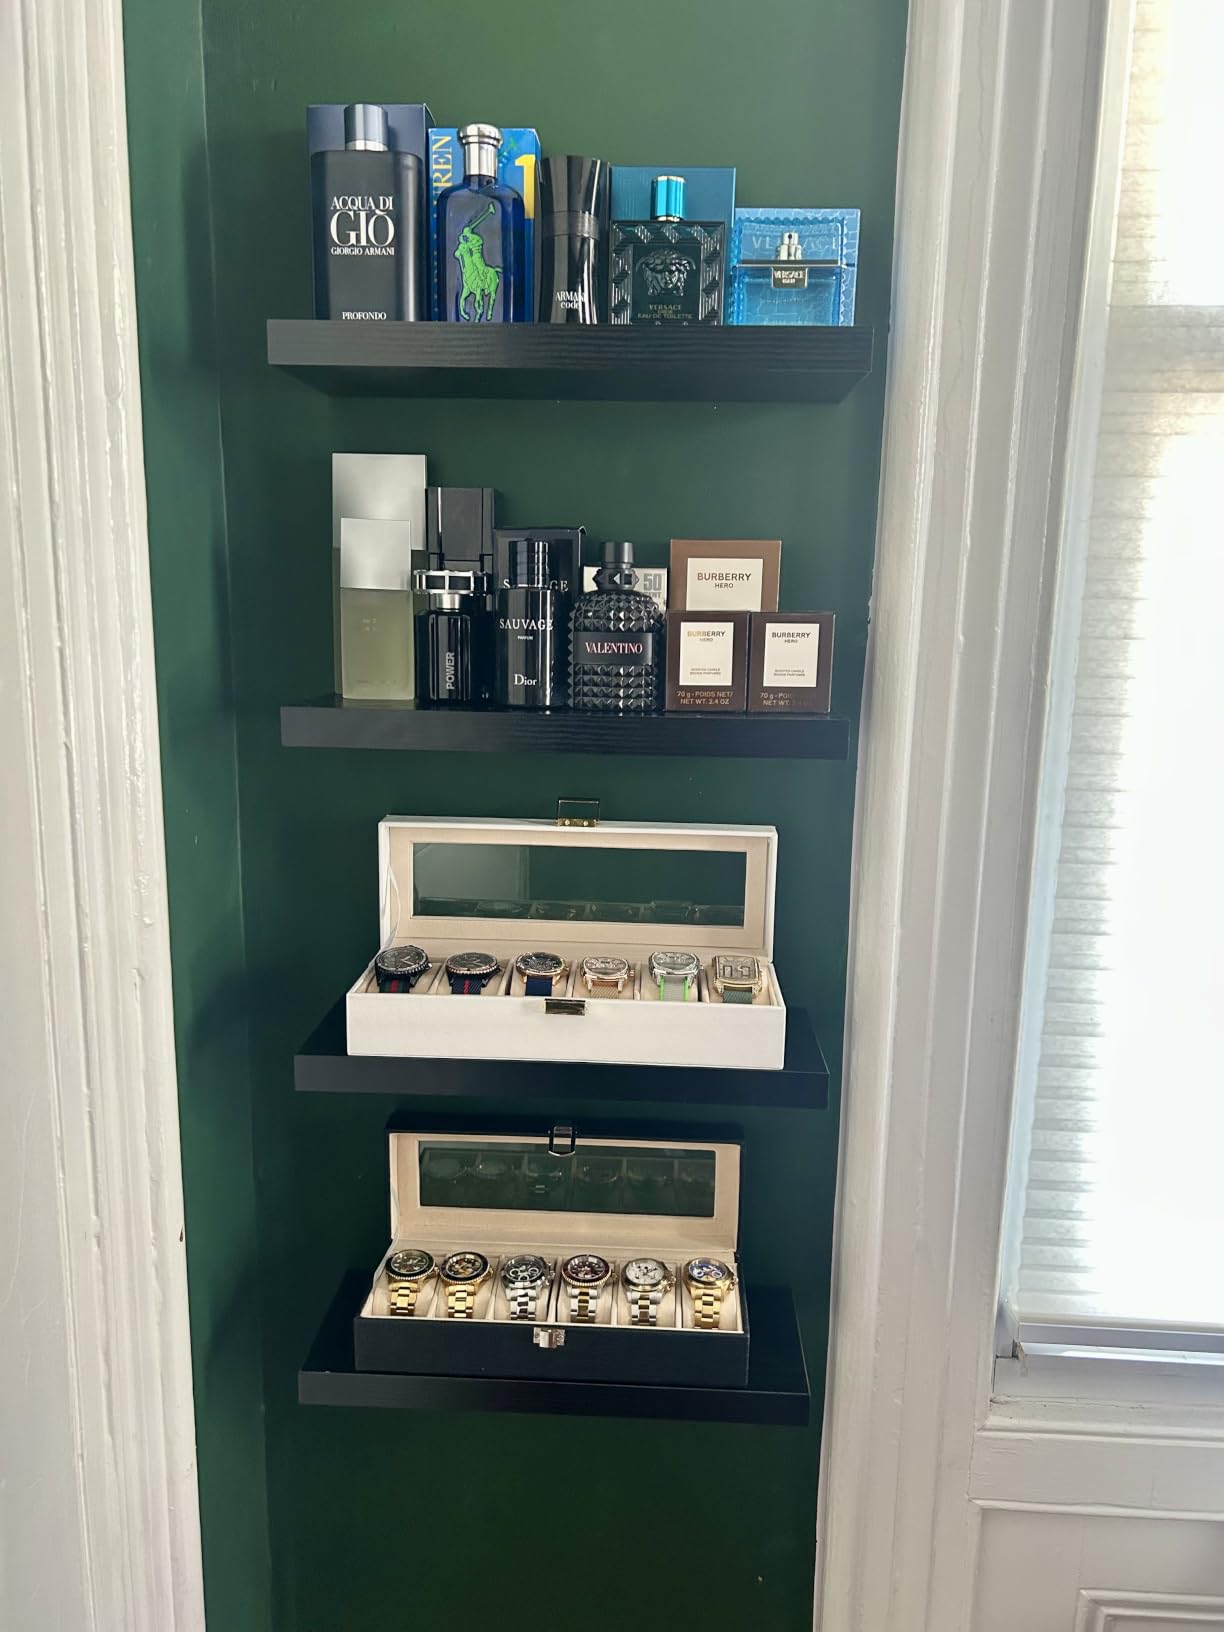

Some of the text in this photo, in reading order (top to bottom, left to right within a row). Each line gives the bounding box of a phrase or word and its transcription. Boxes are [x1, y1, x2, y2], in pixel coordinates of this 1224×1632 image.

[432, 135, 453, 196] REN
[515, 154, 536, 219] 1
[330, 196, 394, 210] ACQUA DI
[330, 246, 395, 256] GIORGIO ARMANI
[555, 290, 588, 302] ARMAN
[342, 311, 387, 320] PROFONDO
[643, 573, 662, 591] 50
[697, 572, 752, 582] BURBERRY
[499, 618, 554, 630] SAUVAGE
[687, 630, 727, 638] BURBERRY
[771, 631, 811, 639] BURBERRY
[585, 641, 643, 655] VALENTINO
[445, 652, 455, 690] POWER
[514, 674, 537, 686] Dior
